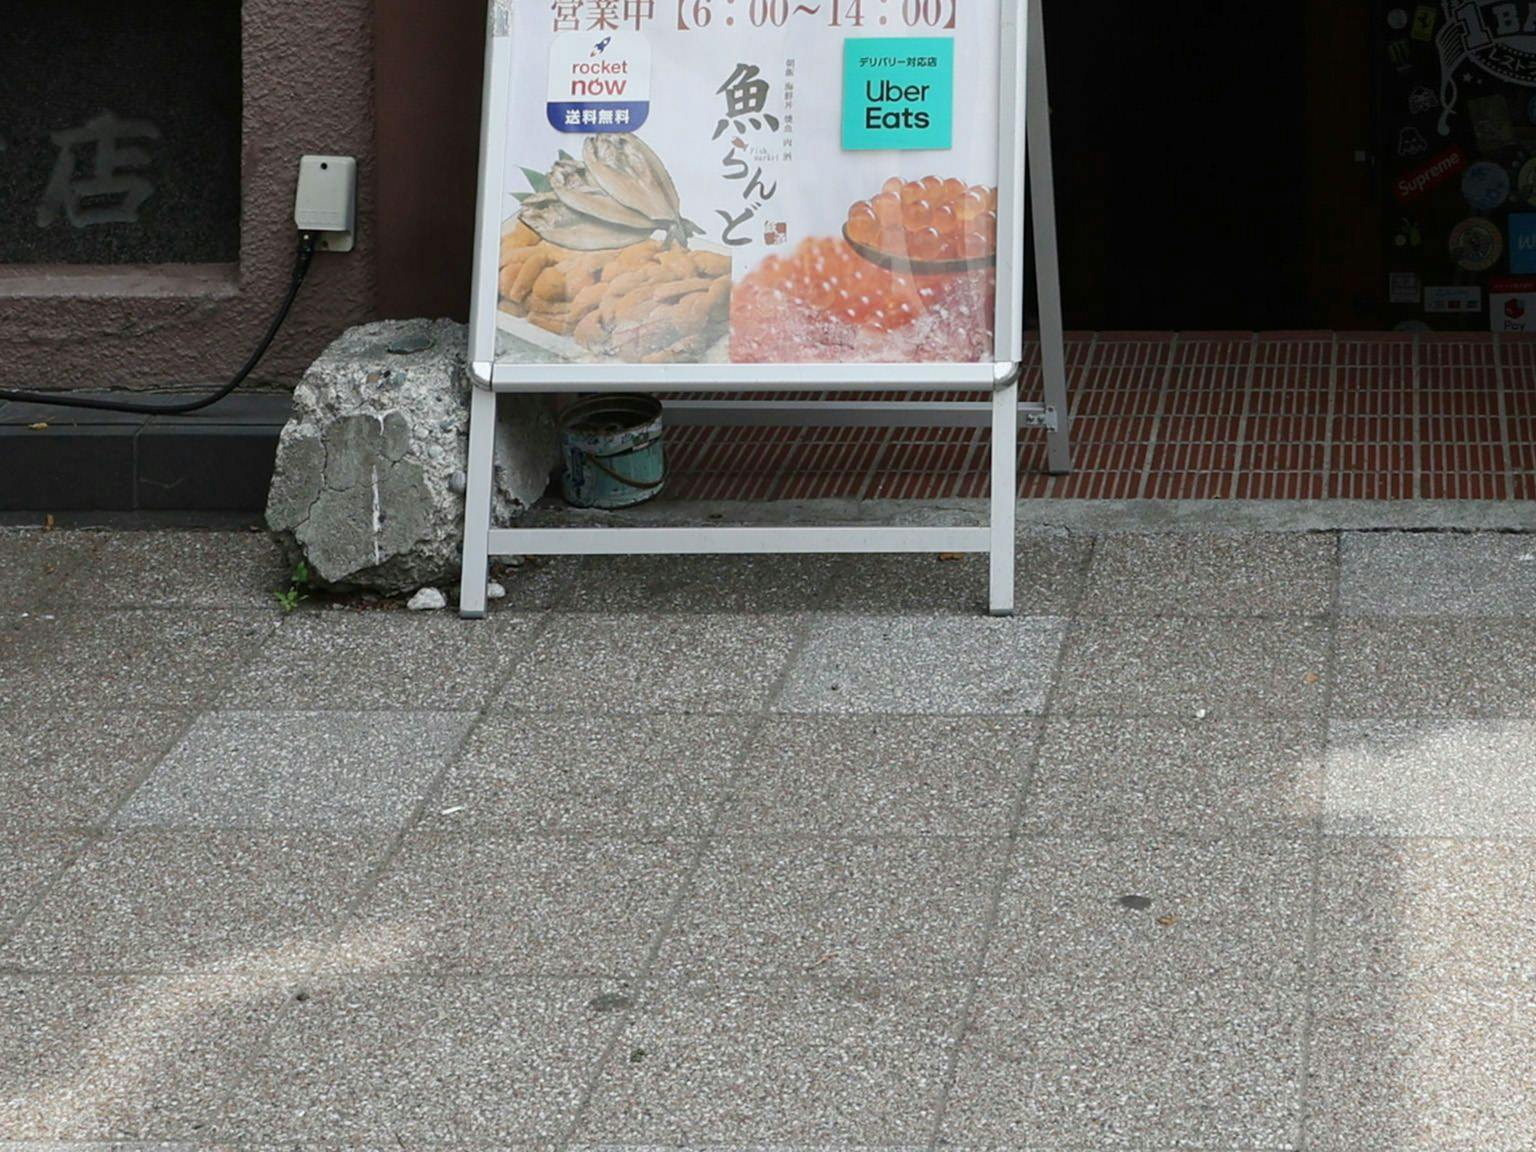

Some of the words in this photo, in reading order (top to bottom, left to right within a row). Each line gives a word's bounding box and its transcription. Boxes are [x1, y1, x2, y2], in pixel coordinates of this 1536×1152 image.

[571, 59, 629, 76] rocket
[858, 55, 938, 69] デリバリー対応店
[570, 77, 627, 97] now
[865, 79, 931, 103] Uber
[564, 108, 631, 126] 送料無料
[865, 107, 930, 130] Eats
[712, 62, 781, 247] 魚らんど
[36, 110, 162, 229] 店
[1397, 151, 1462, 197] Supreme
